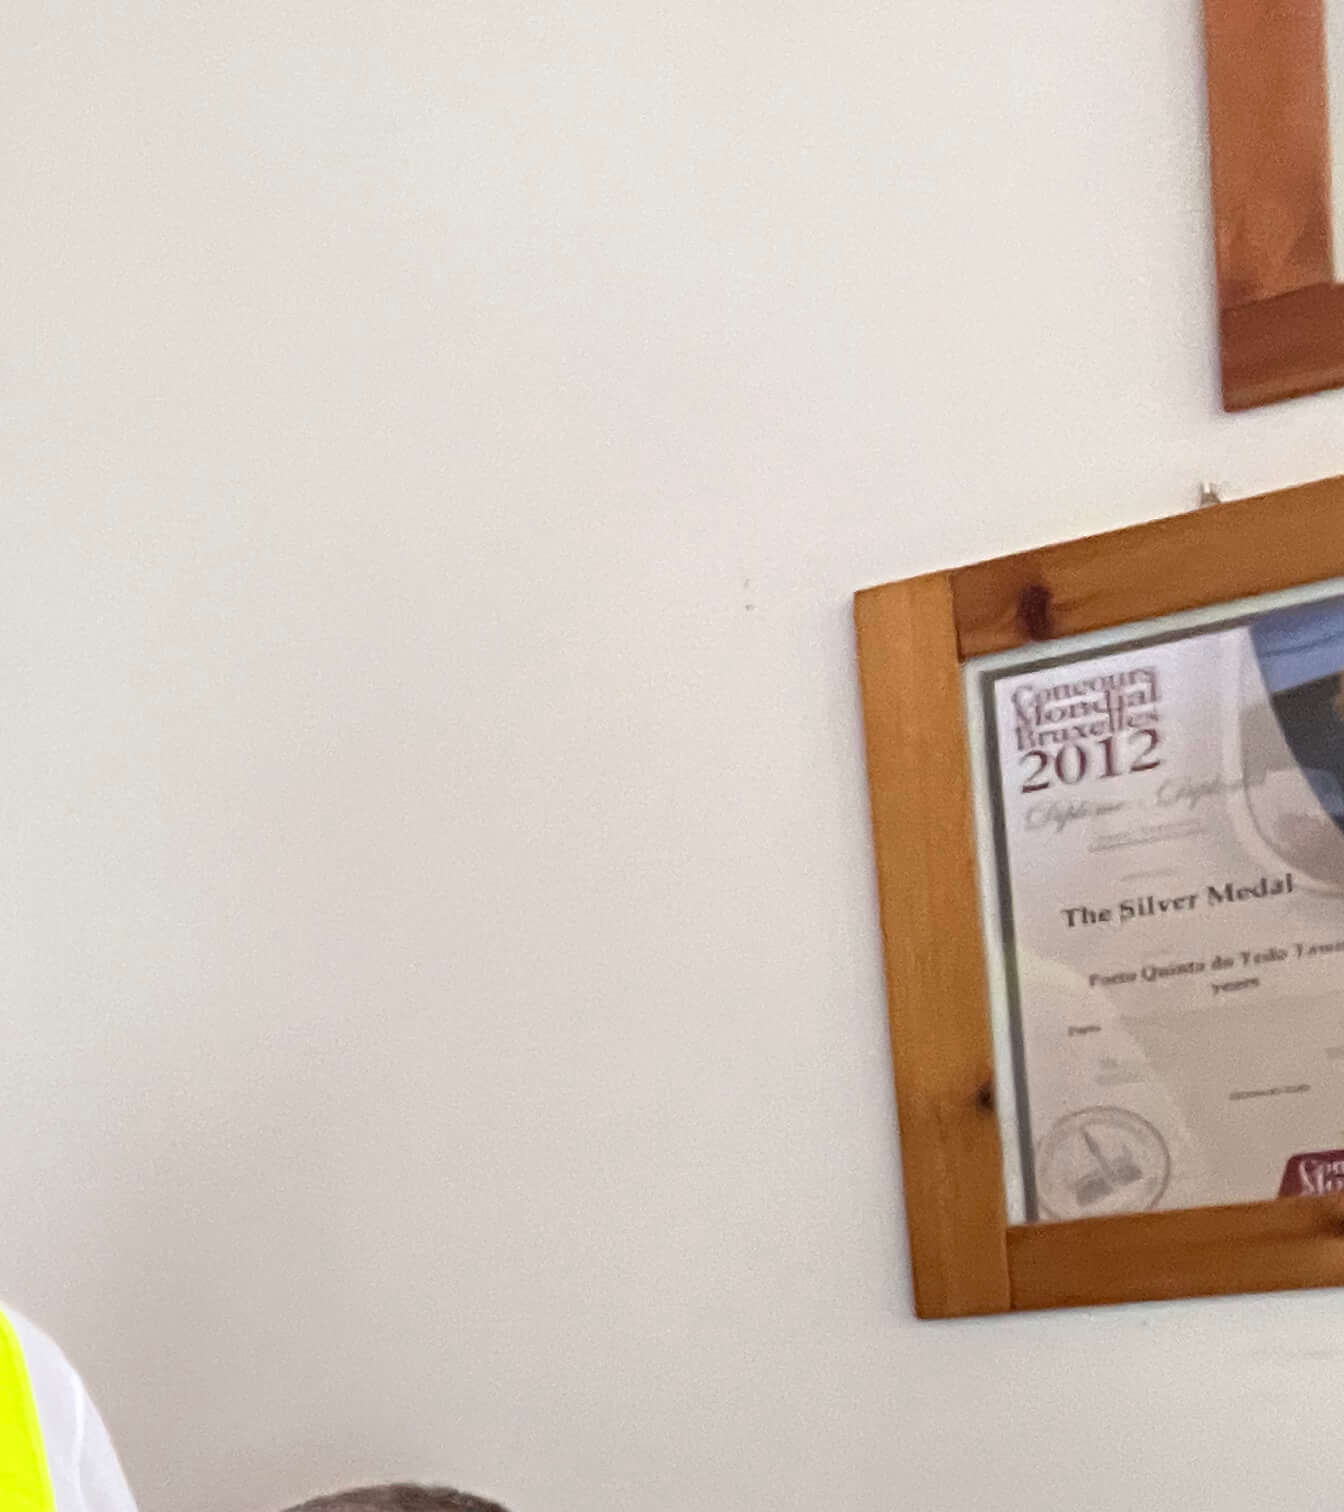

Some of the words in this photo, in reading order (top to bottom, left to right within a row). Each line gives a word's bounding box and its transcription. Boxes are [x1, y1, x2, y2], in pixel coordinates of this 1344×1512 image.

[1019, 728, 1162, 794] 2012
[1062, 905, 1112, 928] The
[1119, 893, 1199, 922] Silver
[1206, 872, 1294, 908] Medal
